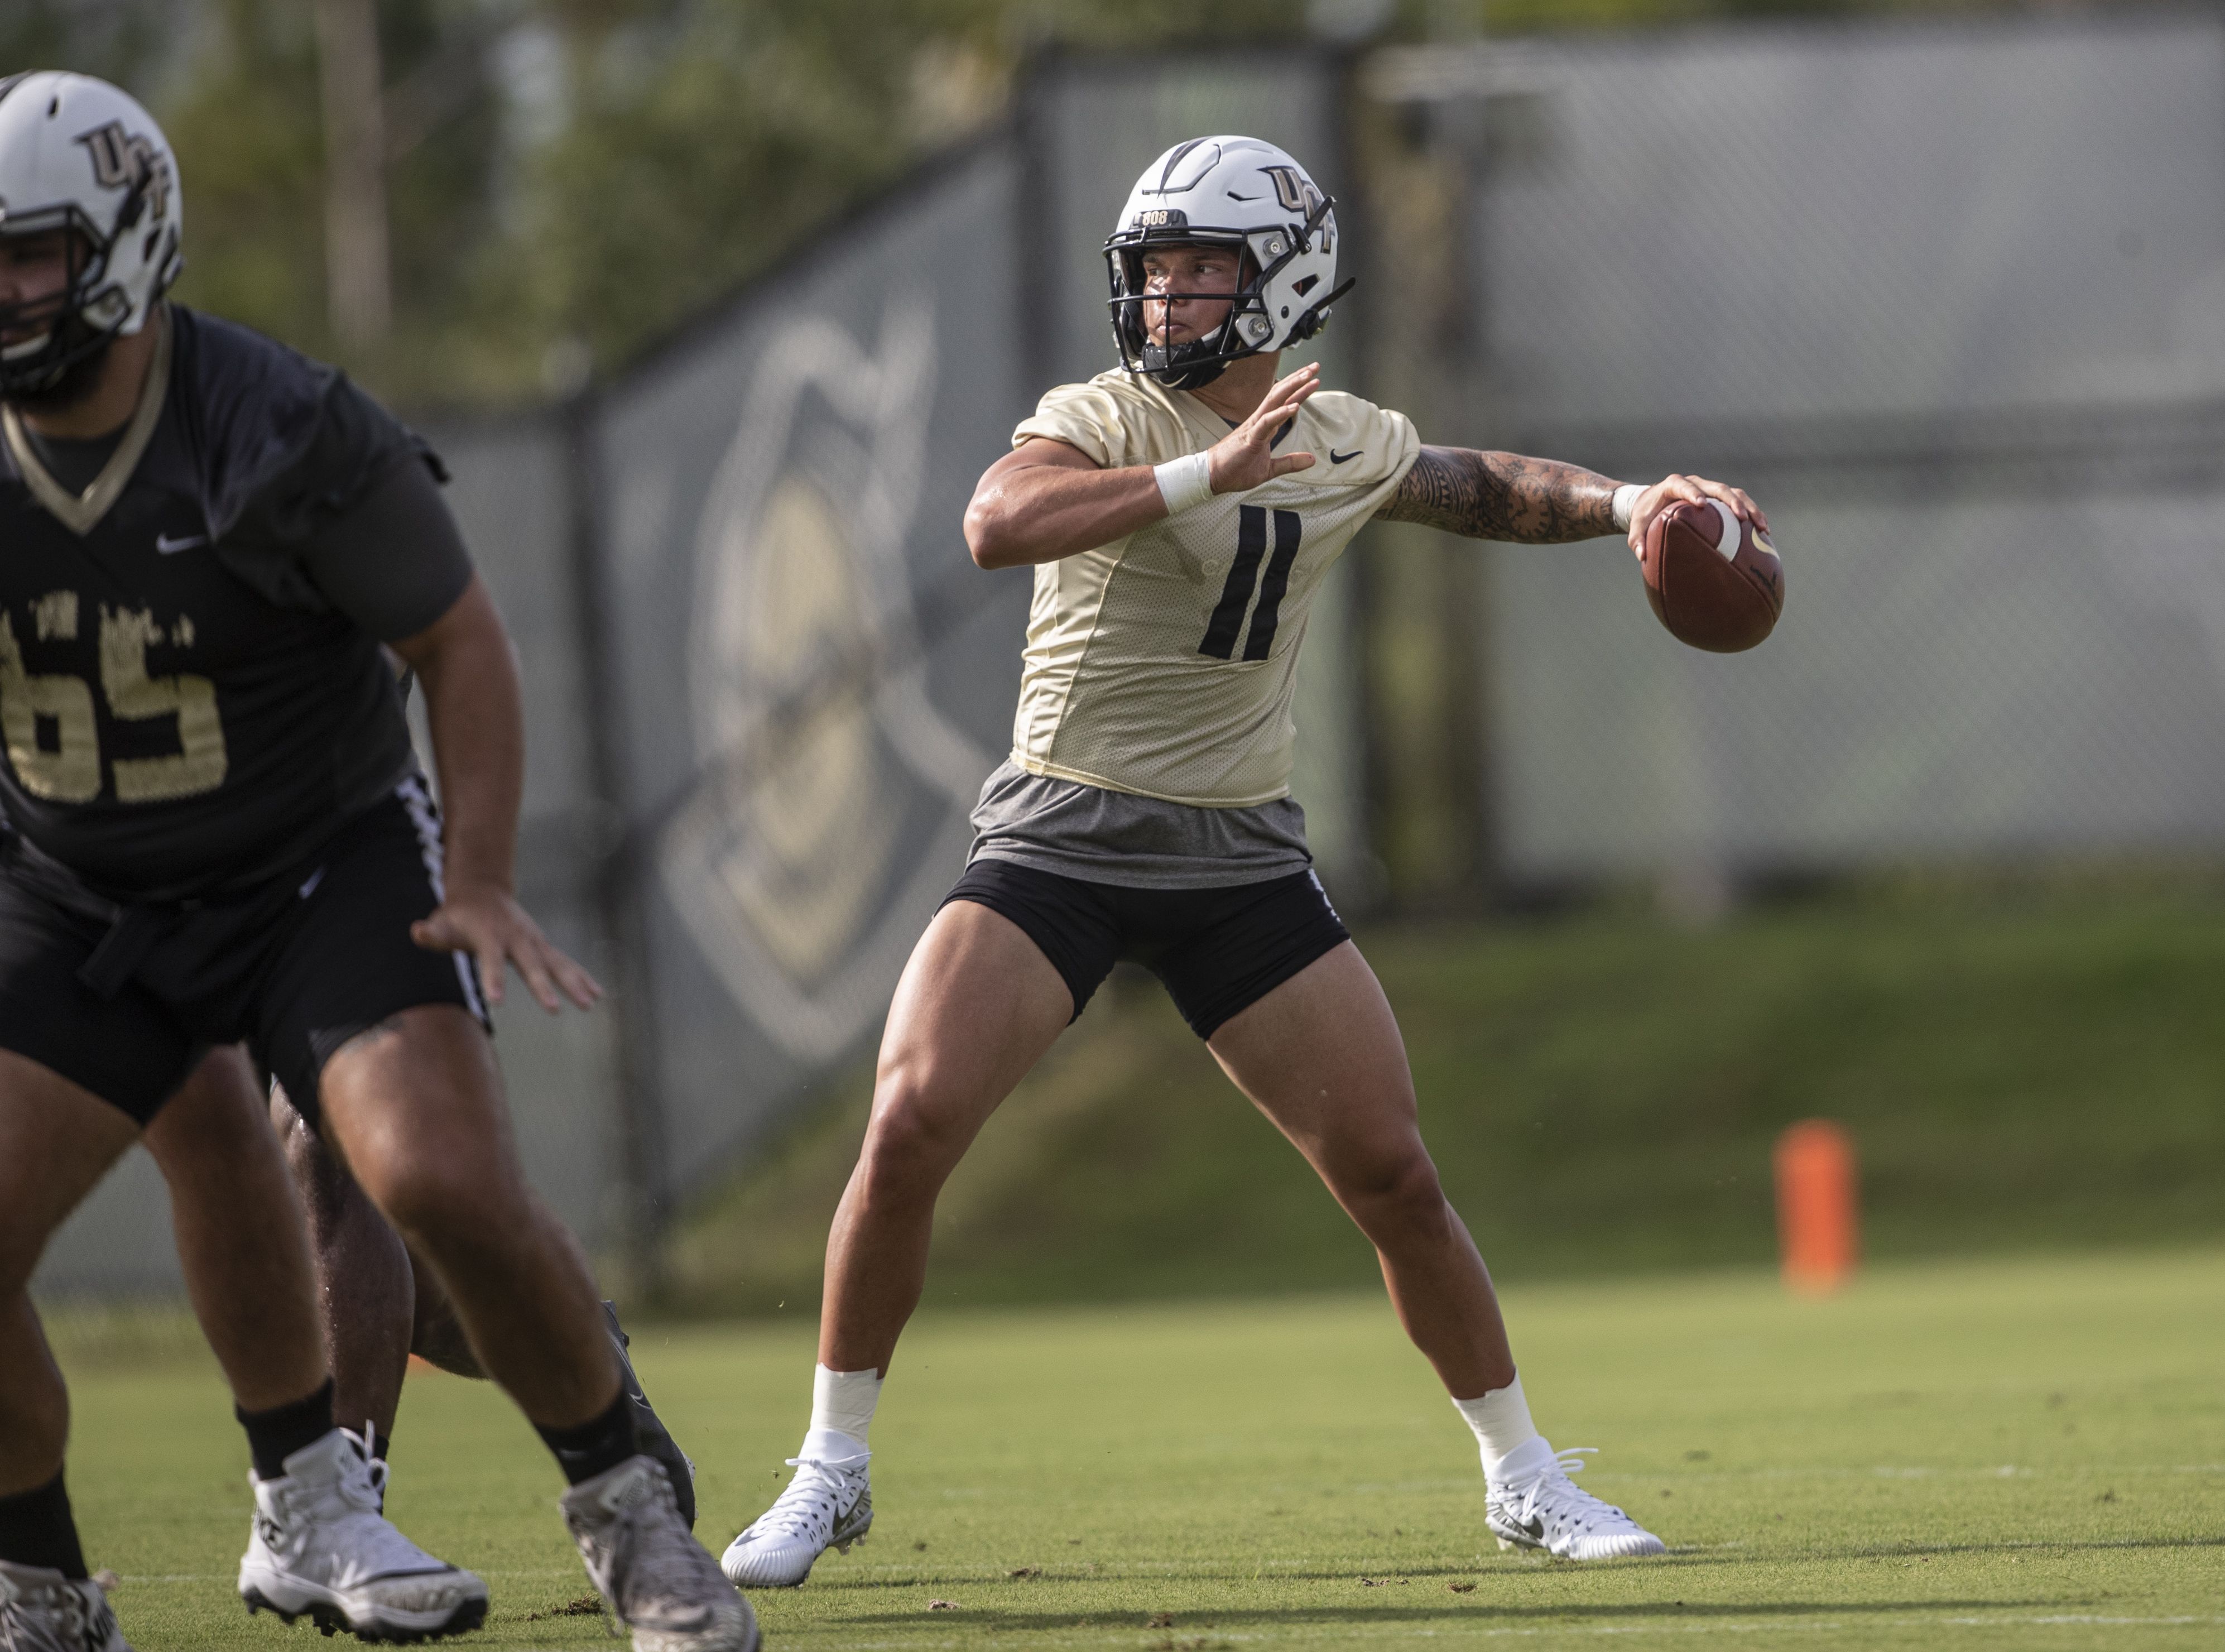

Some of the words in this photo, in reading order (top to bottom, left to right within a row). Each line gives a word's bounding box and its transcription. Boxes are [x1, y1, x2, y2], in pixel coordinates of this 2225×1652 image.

[1142, 210, 1168, 226] 808
[1198, 504, 1302, 662] 11
[0, 589, 228, 804] 65
